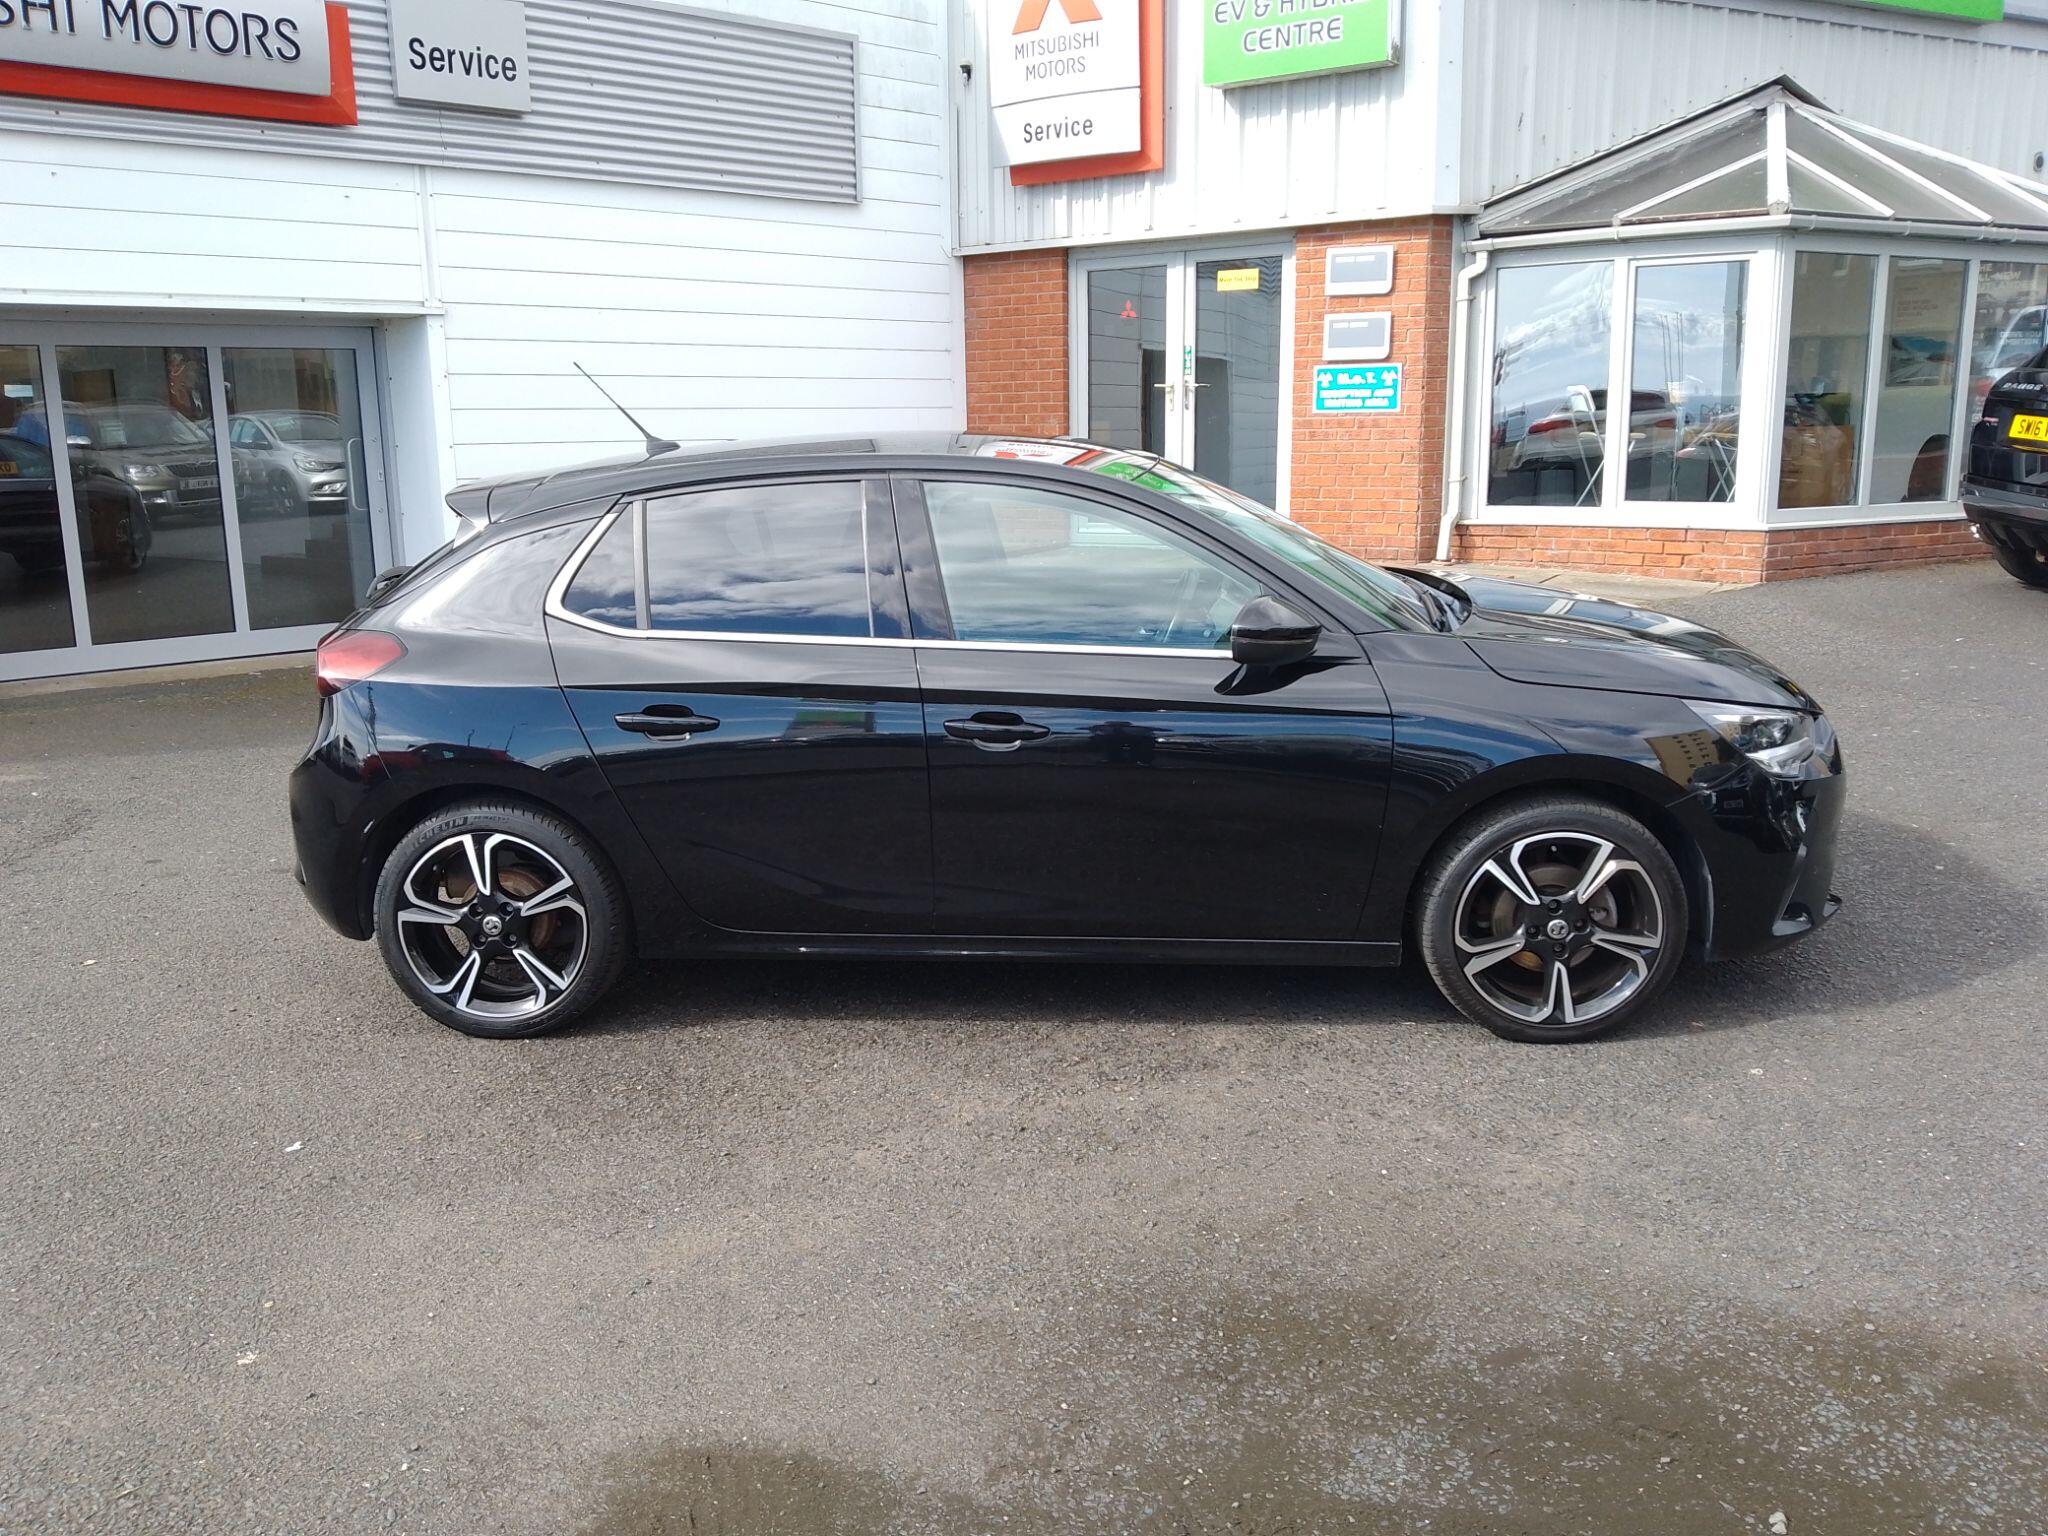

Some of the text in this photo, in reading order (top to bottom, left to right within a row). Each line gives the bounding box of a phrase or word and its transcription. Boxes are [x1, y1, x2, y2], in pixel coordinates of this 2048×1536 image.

[1215, 1, 1245, 23] EV
[103, 0, 301, 61] MOTORS
[1244, 18, 1341, 52] CENTRE
[408, 37, 517, 81] Service
[1015, 31, 1099, 60] MITSUBISHI
[1026, 56, 1086, 81] MOTORS
[1024, 116, 1093, 143] Service
